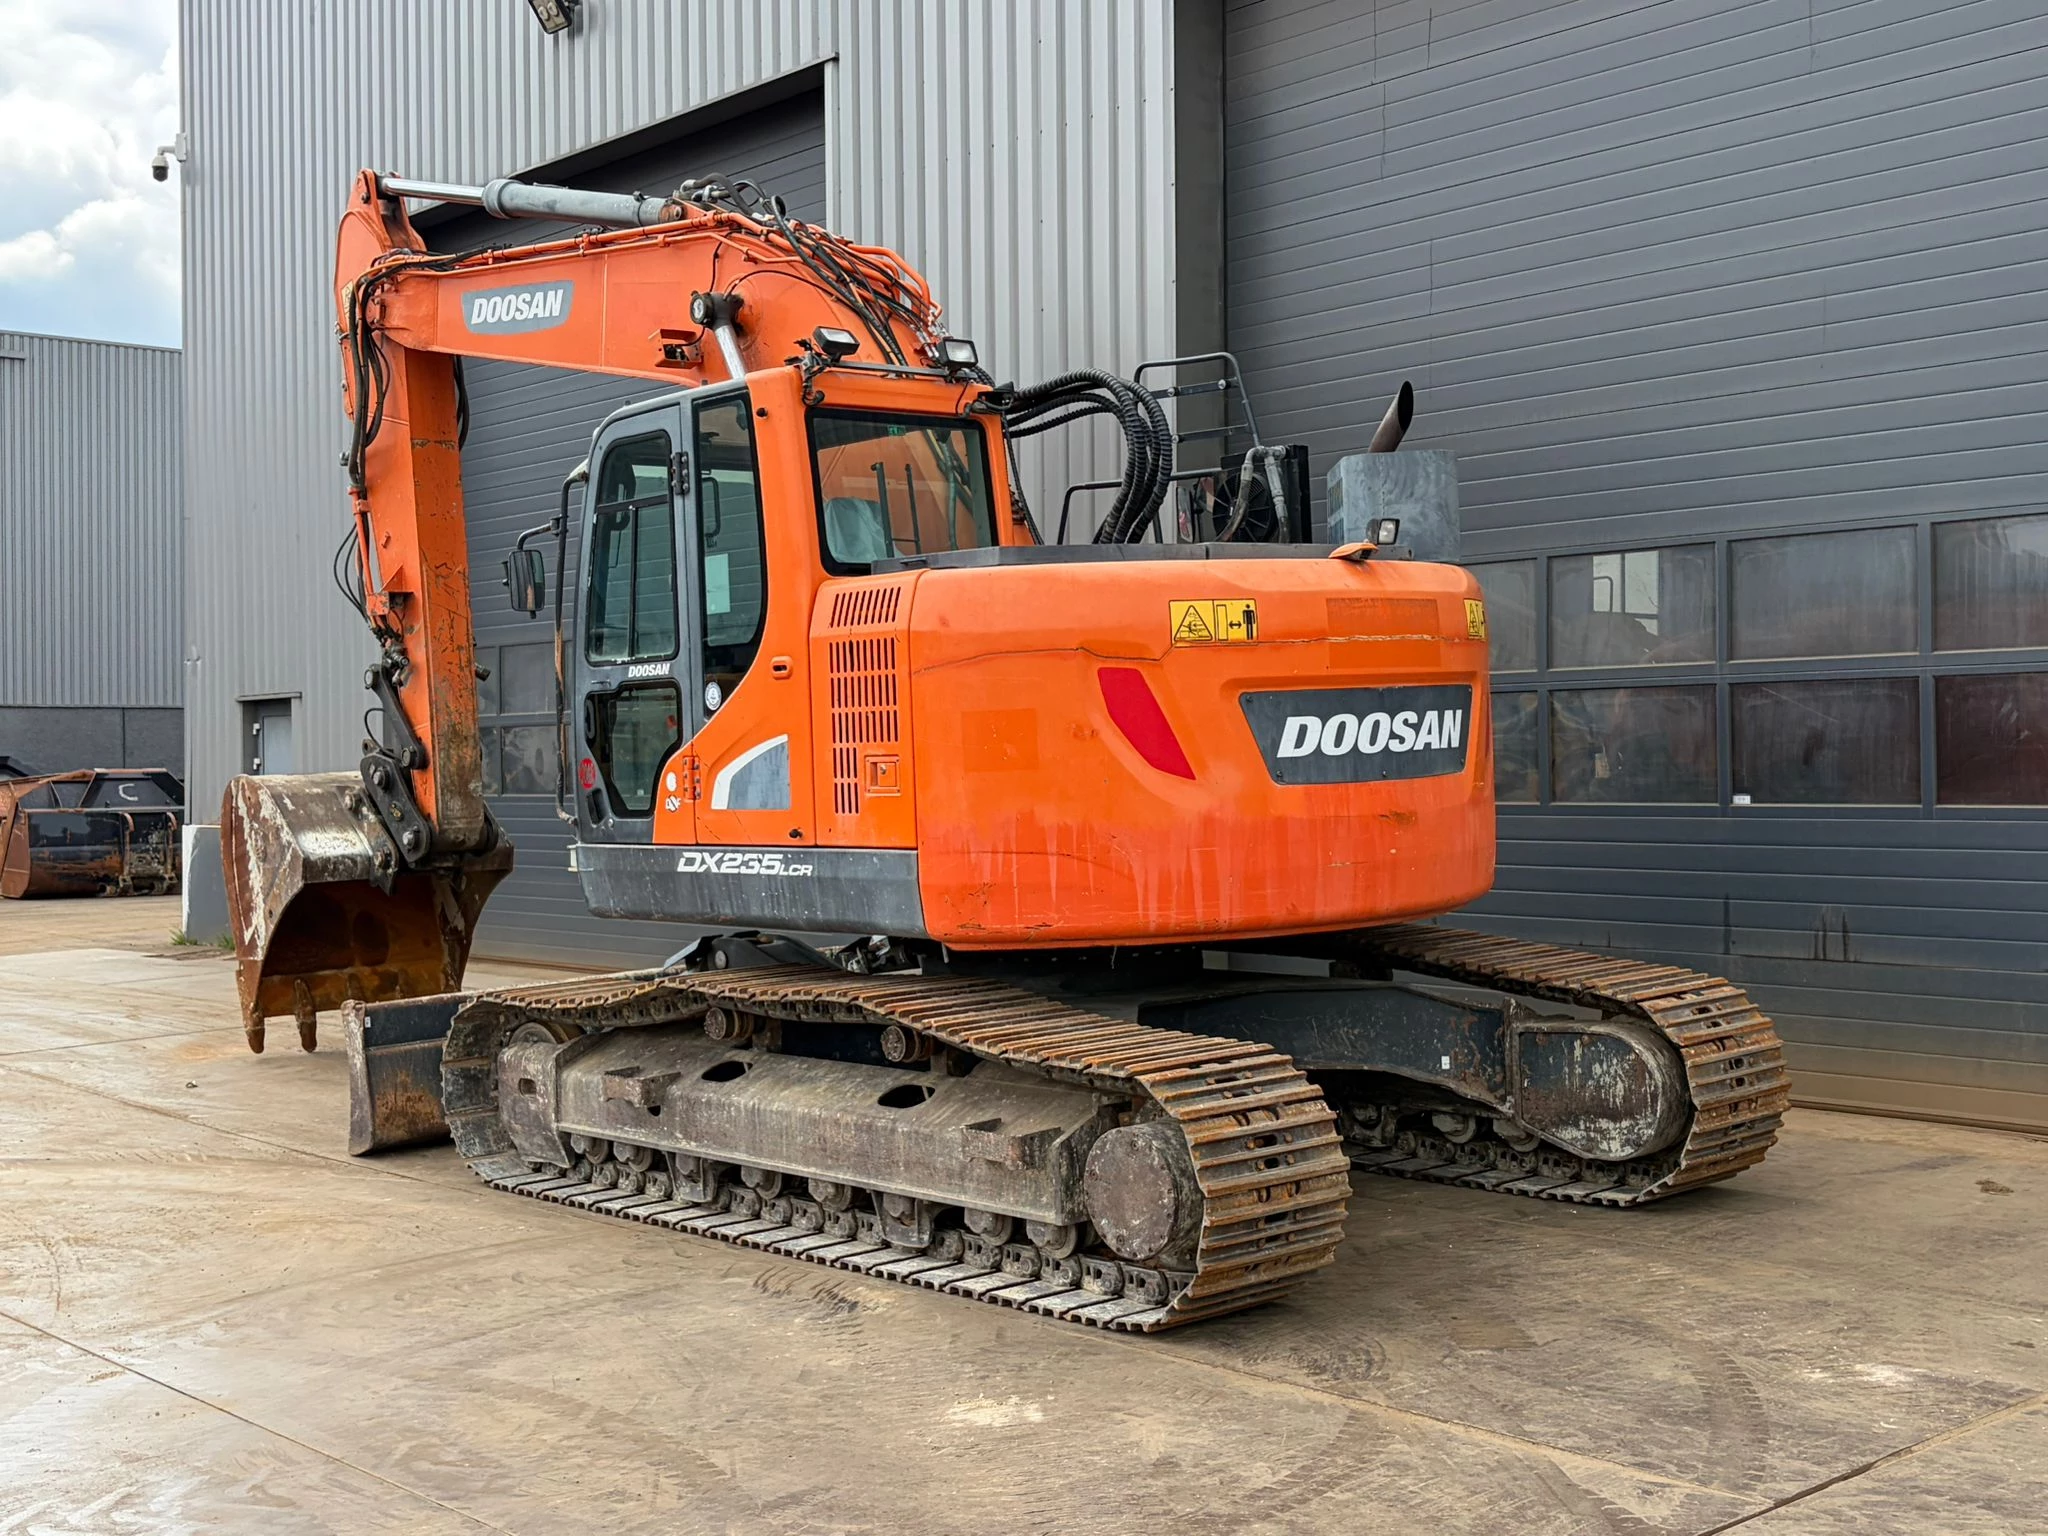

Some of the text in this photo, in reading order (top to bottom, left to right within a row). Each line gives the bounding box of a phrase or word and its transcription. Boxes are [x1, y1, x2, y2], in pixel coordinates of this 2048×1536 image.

[471, 289, 563, 324] DOOSAN
[628, 663, 670, 677] DOOSAN
[1277, 709, 1462, 758] DOOSAN
